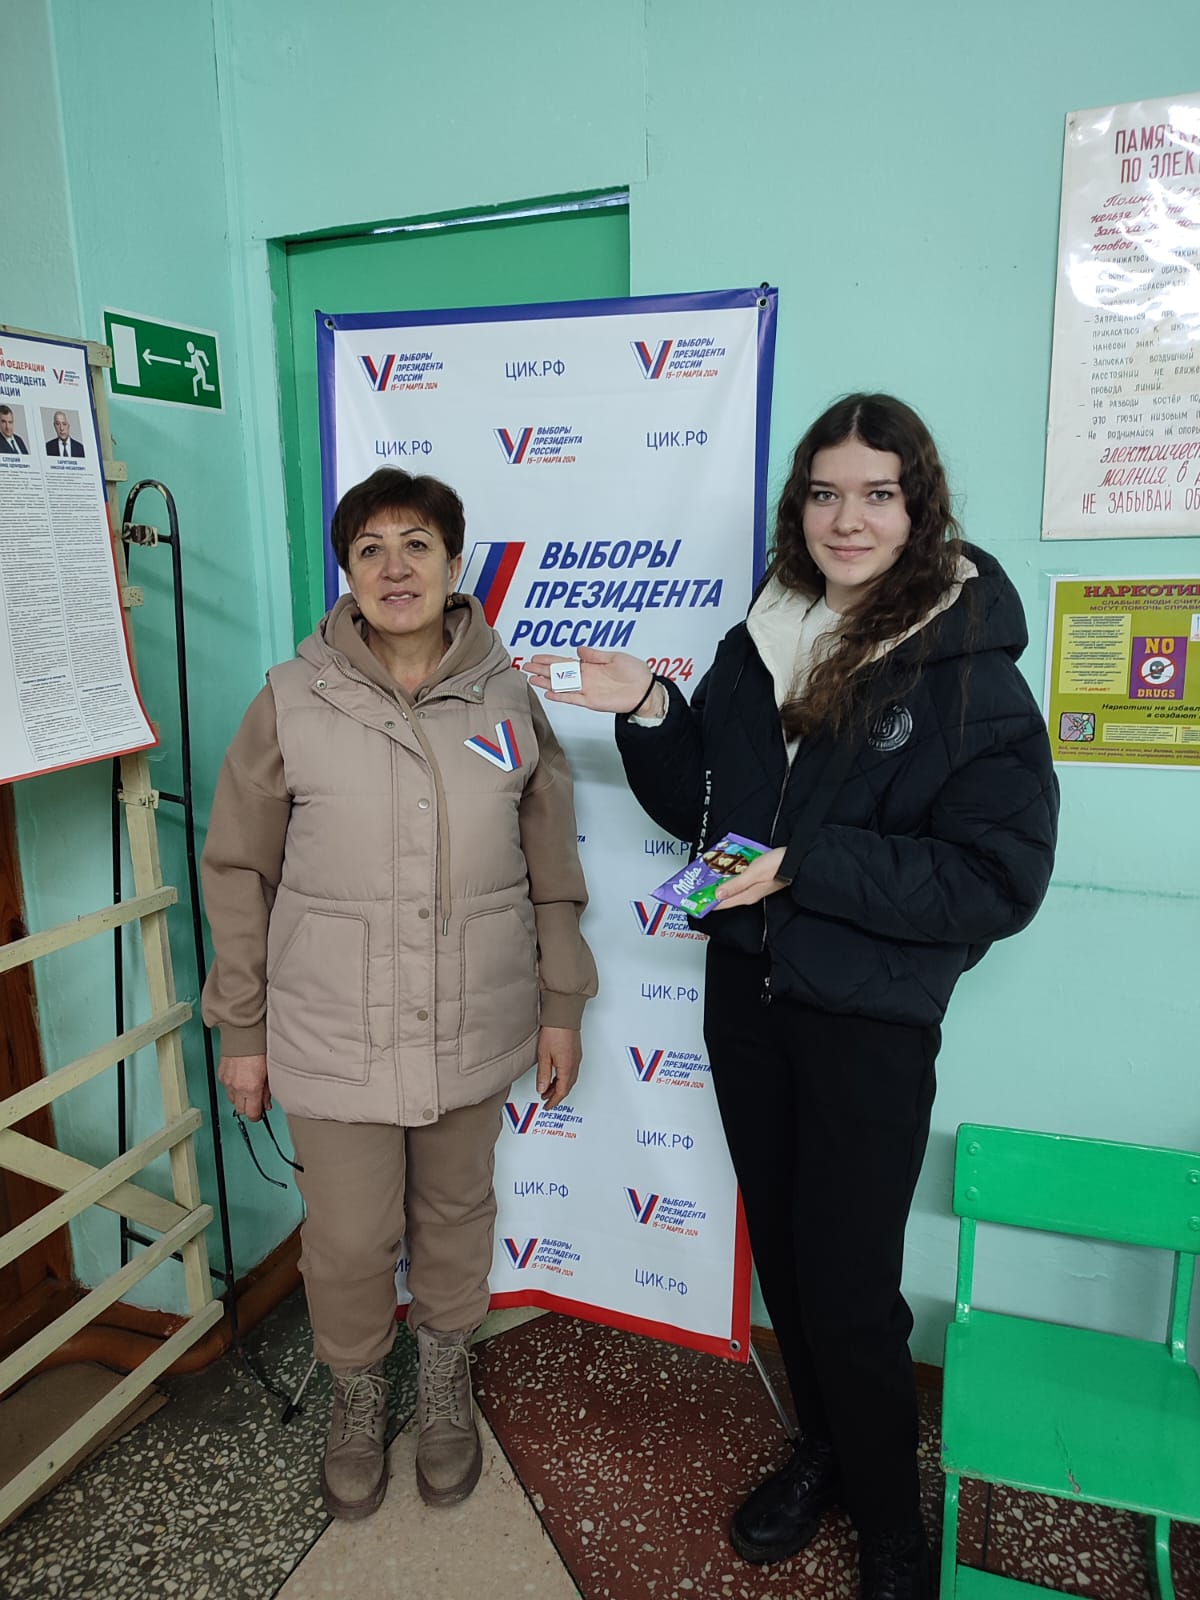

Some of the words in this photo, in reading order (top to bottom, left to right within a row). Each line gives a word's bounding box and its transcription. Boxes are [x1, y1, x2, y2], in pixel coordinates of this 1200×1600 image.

[1121, 157, 1142, 184] ПО
[1149, 150, 1200, 179] ЭЛЕК
[677, 337, 715, 348] ВЫБОРЫ
[399, 352, 433, 362] ВЫБОРЫ
[673, 348, 726, 359] ПРЕЗИДЕНТА
[6, 360, 46, 373] ФЕДЕРАЦИИ
[396, 362, 443, 372] ПРЕЗИДЕНТА
[505, 360, 565, 381] ЦИК.РФ
[668, 360, 703, 370] РОССИИ
[0, 373, 46, 387] ПРЕЗИДЕНТА
[393, 374, 423, 383] РОССИИ
[537, 426, 572, 435] ВЫБОРЫ
[533, 435, 583, 446] ПРЕЗИДЕНТА
[646, 429, 708, 451] ЦИК.РФ
[375, 440, 433, 458] ЦИК.РФ
[530, 447, 561, 455] РОССИИ
[1082, 492, 1097, 515] НЕ
[1107, 483, 1173, 515] ЗАБЫВАЙ
[539, 539, 682, 570] ВЫБОРЫ
[524, 578, 724, 613] ПРЕЗИДЕНТА
[510, 619, 636, 647] РОССИИ
[1144, 638, 1175, 654] NO
[1137, 688, 1176, 698] DRUGS
[1102, 703, 1152, 711] Наркотики
[644, 839, 691, 857] ЦИК.Р
[672, 867, 702, 895] Milka
[641, 983, 699, 1002] ЦИК.РФ
[667, 1051, 702, 1061] ВЫБОРЫ
[663, 1060, 712, 1073] ПРЕЗИДЕНТА
[659, 1069, 691, 1079] РОССИИ
[538, 1112, 583, 1123] ПРЕЗИДЕНТА
[636, 1129, 694, 1150] ЦИК.РФ
[514, 1181, 569, 1199] ЦИК.РФ
[662, 1197, 697, 1209] ВЫБОРЫ
[658, 1205, 707, 1220] ПРЕЗИДЕНТА
[655, 1215, 685, 1226] РОССИИ
[541, 1238, 573, 1250] ВЫБОРЫ
[534, 1255, 562, 1266] РОССИИ
[538, 1247, 581, 1261] ПРЕЗИДЕНТА
[635, 1268, 688, 1295] ЦИК.РФ
